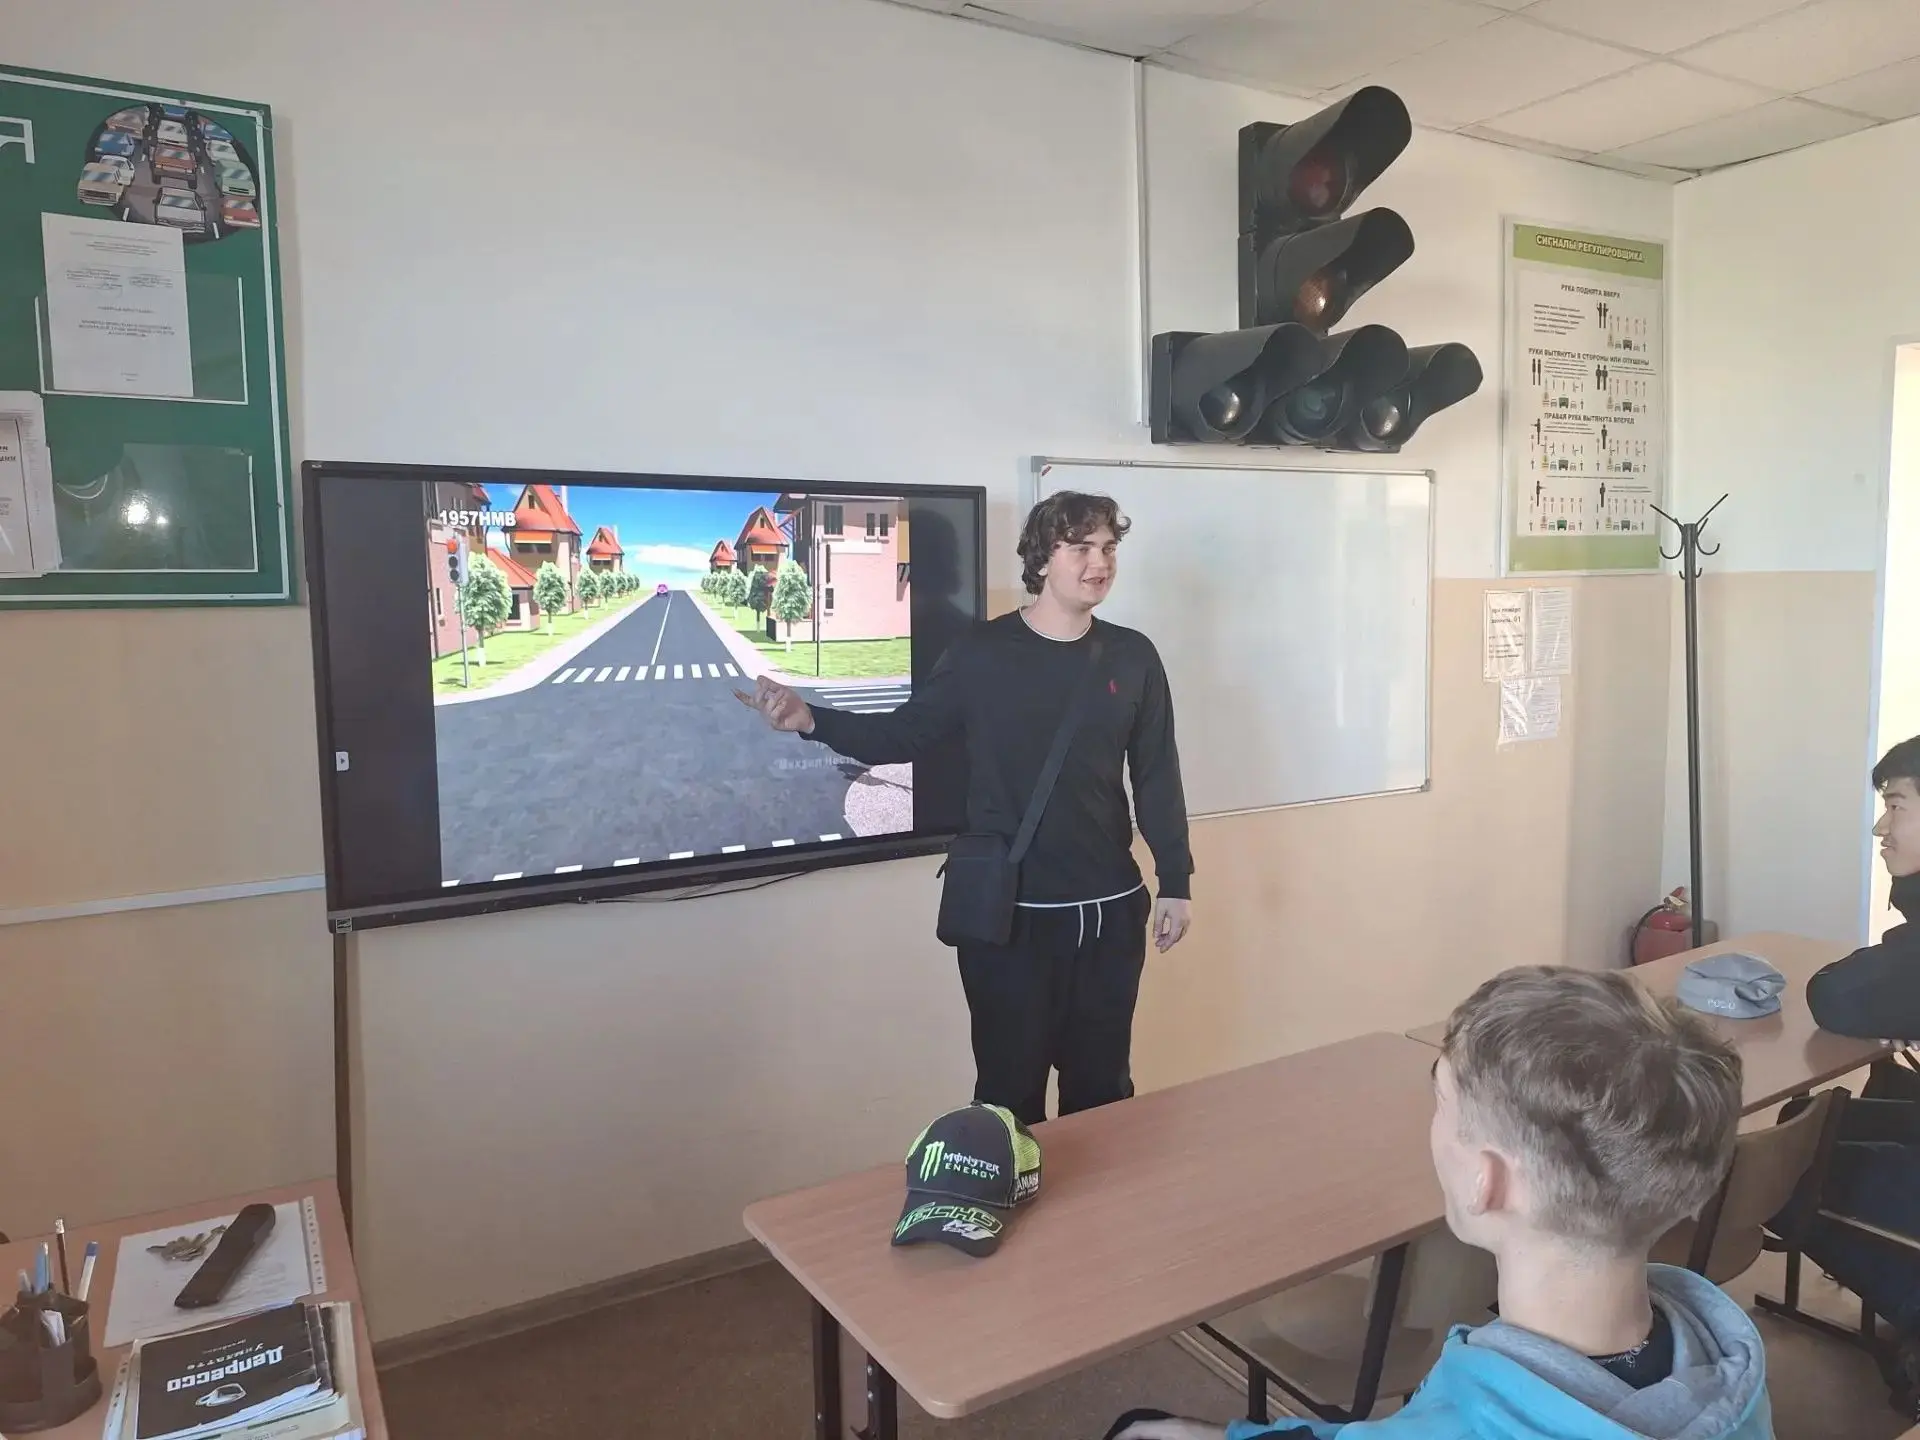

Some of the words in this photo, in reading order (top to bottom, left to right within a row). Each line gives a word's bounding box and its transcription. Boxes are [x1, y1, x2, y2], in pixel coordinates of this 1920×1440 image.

[1536, 235, 1578, 250] СИГНАЛЫ
[1578, 242, 1644, 263] РЕГУЛИРОВЩИКА
[1561, 284, 1575, 292] РУКА
[1528, 347, 1543, 355] РУКИ
[1544, 349, 1576, 359] ВЫТЯНУТЫ
[1582, 353, 1608, 362] СТОРОНЫ
[1544, 412, 1566, 420] ПРАВАЯ
[1582, 415, 1612, 423] ВЫТЯНУТА
[943, 1152, 1000, 1176] MONSTER
[945, 1163, 995, 1181] ENERGY
[166, 1345, 284, 1392] Депрессо
